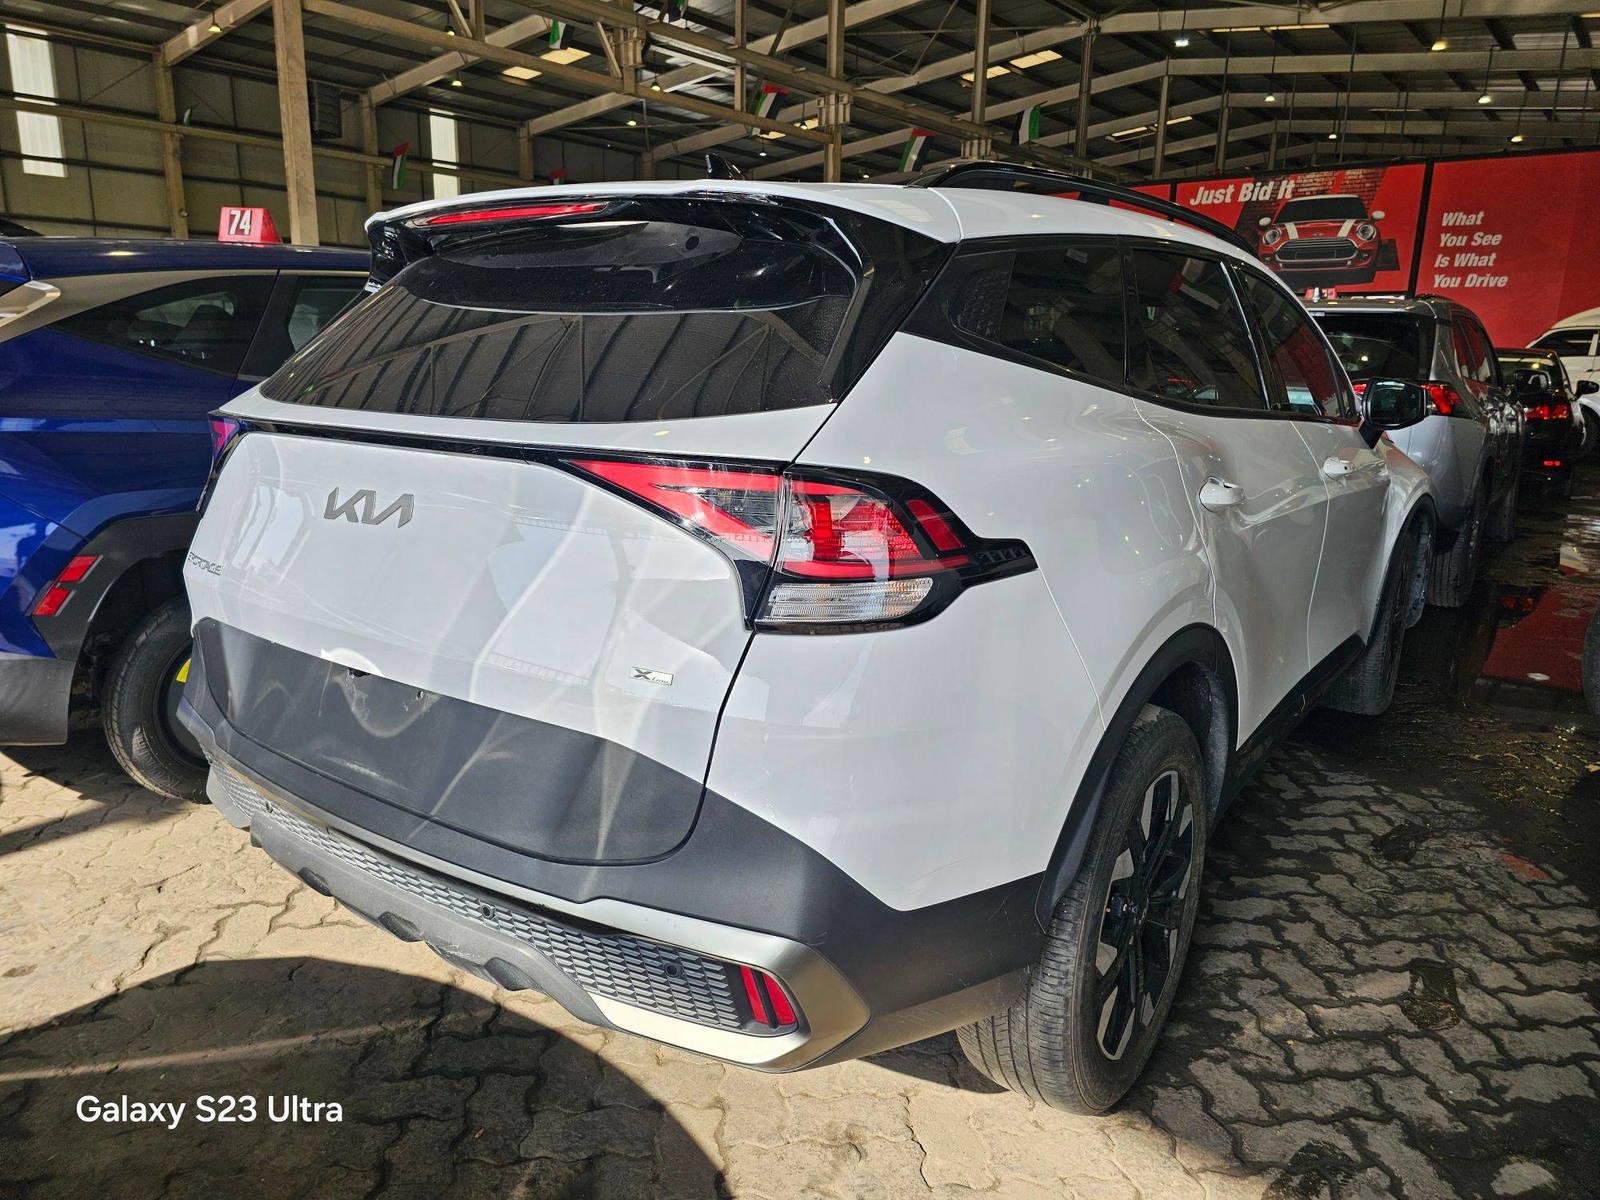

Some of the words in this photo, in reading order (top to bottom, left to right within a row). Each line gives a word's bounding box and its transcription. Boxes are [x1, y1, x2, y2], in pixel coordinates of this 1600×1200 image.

[1190, 184, 1235, 206] Just
[1238, 181, 1275, 203] Bid
[1277, 179, 1296, 199] It
[229, 209, 252, 235] 74
[1442, 211, 1485, 226] What
[1440, 233, 1468, 247] You
[1471, 231, 1503, 246] See
[1434, 254, 1451, 268] Is
[1454, 252, 1497, 267] What
[1433, 274, 1461, 288] You
[1464, 273, 1509, 288] Drive
[324, 487, 414, 528] KIA
